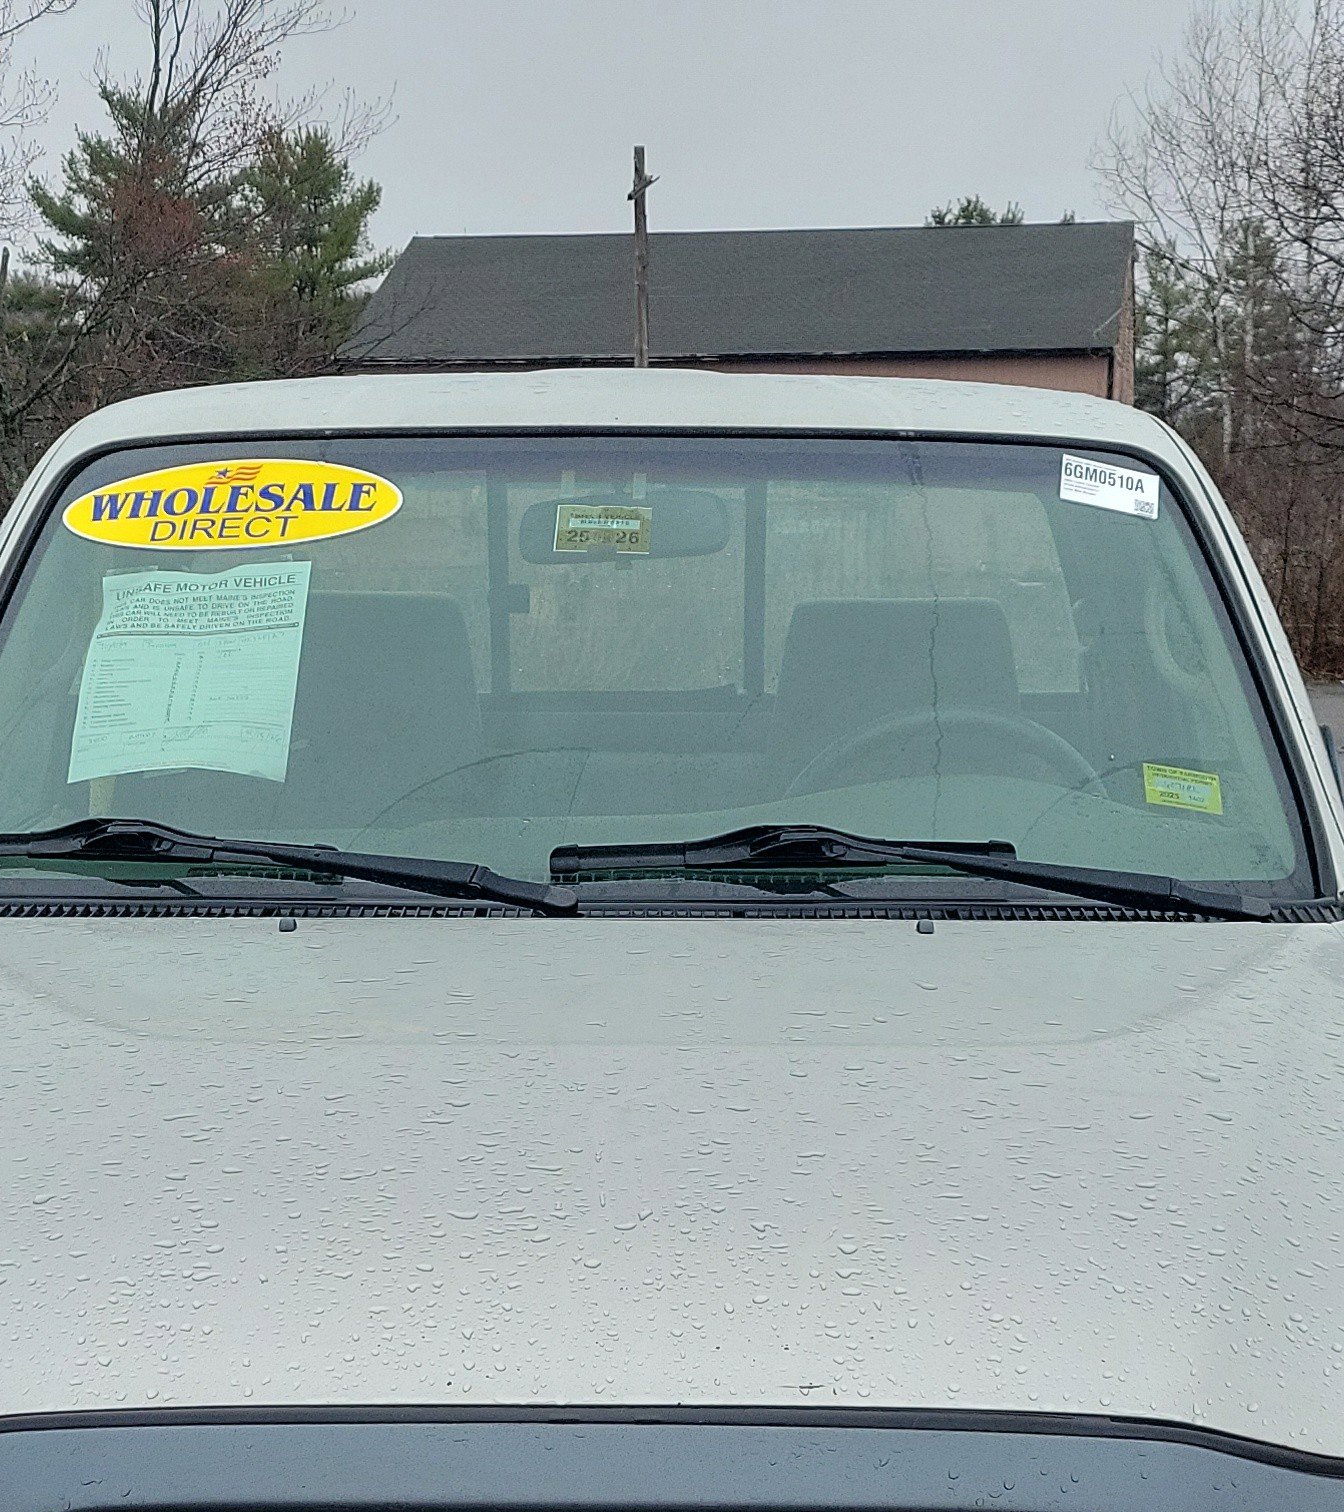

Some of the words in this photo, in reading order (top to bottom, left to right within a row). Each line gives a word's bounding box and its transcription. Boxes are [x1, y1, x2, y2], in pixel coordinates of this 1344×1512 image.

[1064, 462, 1144, 493] 6GM0510A
[91, 482, 377, 522] WHOLESALE
[150, 515, 298, 542] DIRECT
[567, 530, 589, 543] 25
[616, 530, 639, 543] 26
[176, 579, 228, 592] MOTOR
[234, 574, 296, 588] VEHICLE
[149, 597, 171, 605] DOES
